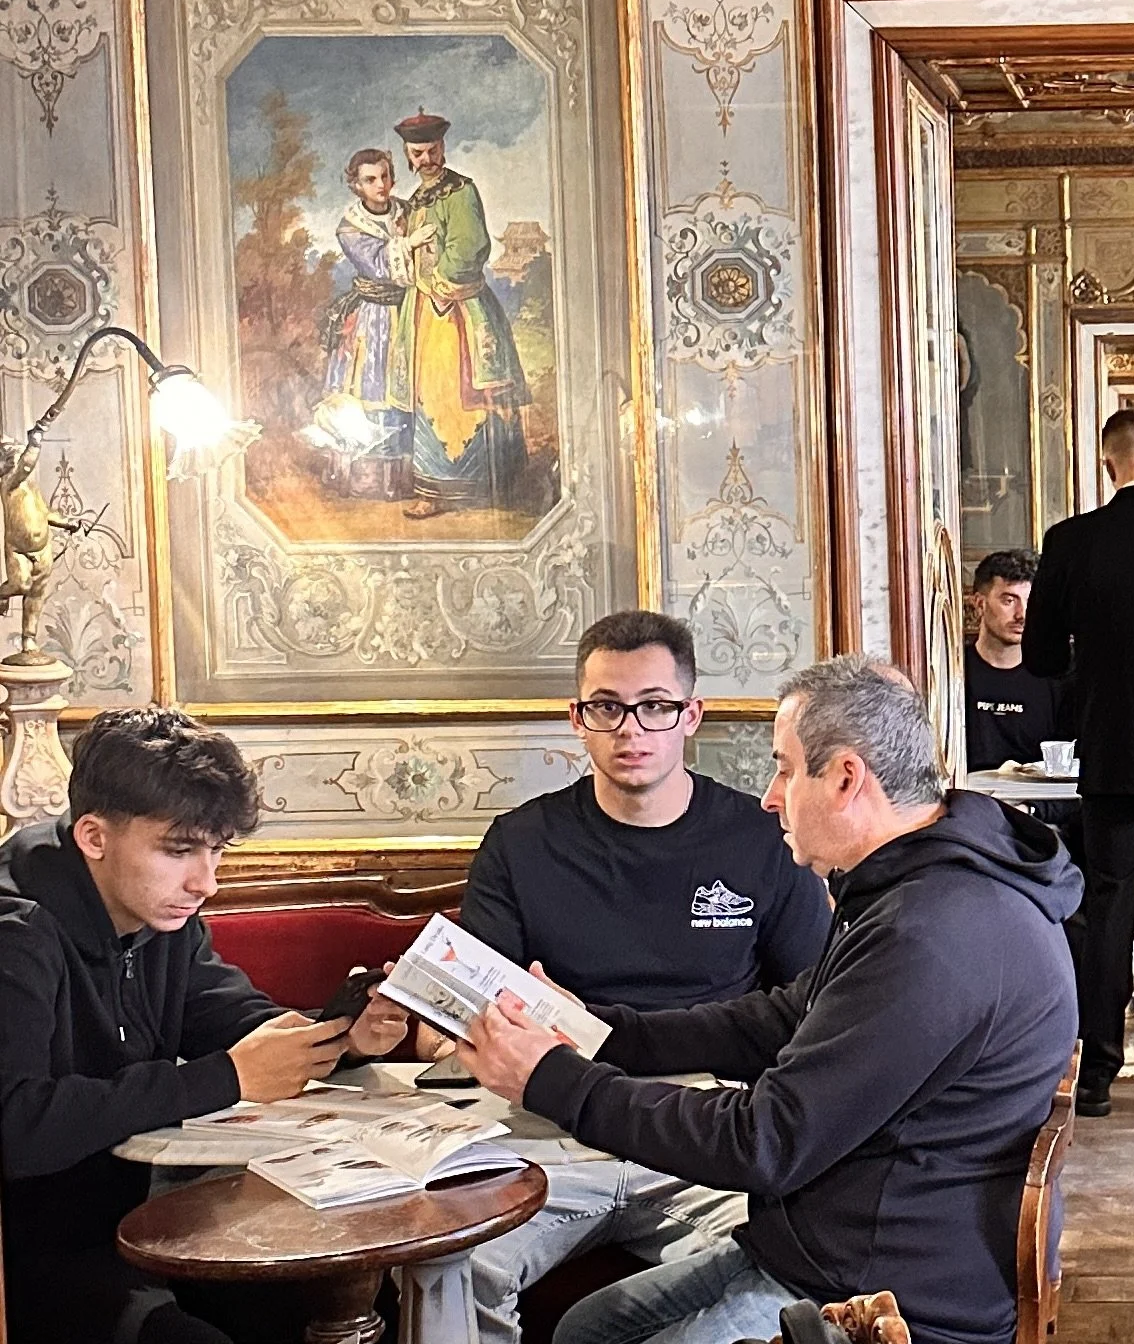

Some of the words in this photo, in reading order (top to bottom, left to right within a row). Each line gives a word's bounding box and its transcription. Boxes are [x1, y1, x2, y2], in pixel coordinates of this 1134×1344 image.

[996, 703, 1024, 713] JEANS
[690, 919, 712, 928] new
[712, 916, 754, 927] balance
